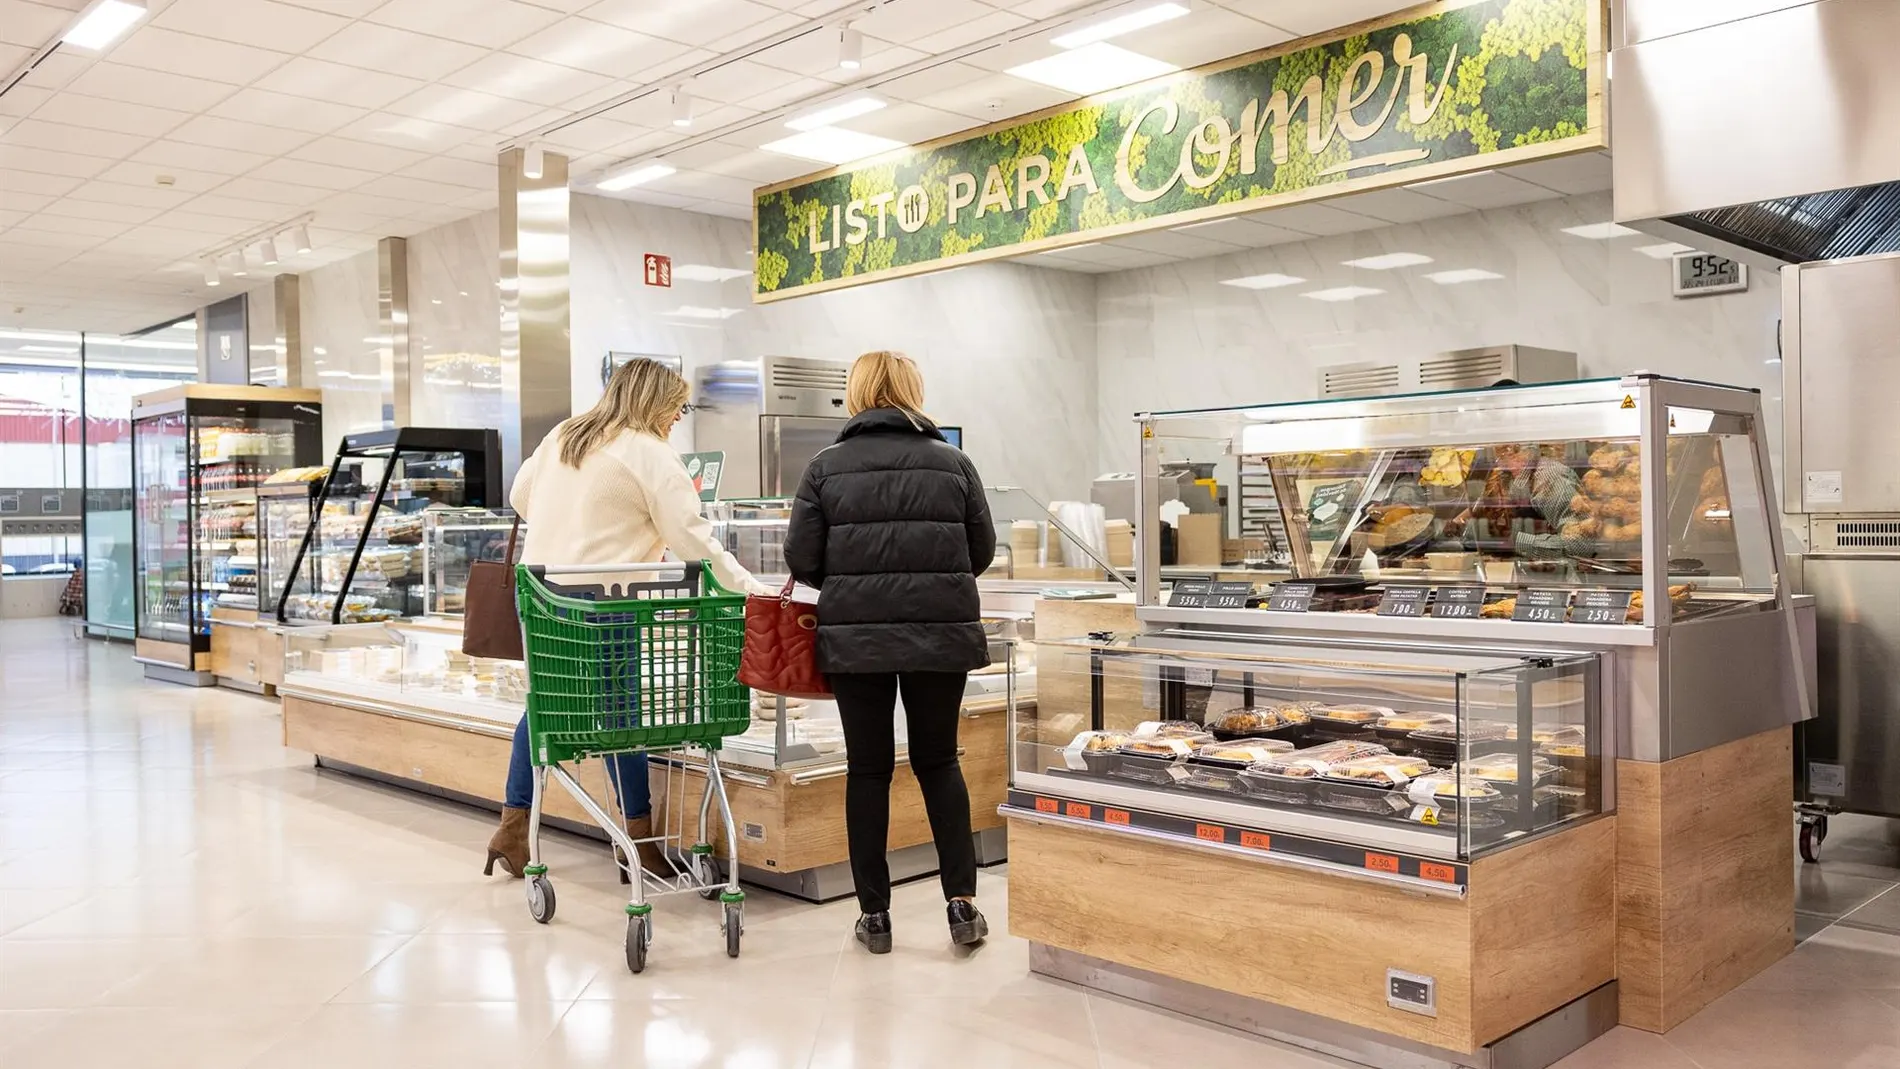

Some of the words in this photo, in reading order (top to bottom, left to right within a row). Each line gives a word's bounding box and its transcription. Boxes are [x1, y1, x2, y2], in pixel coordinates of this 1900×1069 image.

[808, 185, 930, 254] LISTO
[948, 143, 1099, 225] PARA
[1114, 32, 1458, 203] Comer
[1692, 255, 1730, 278] 9:52
